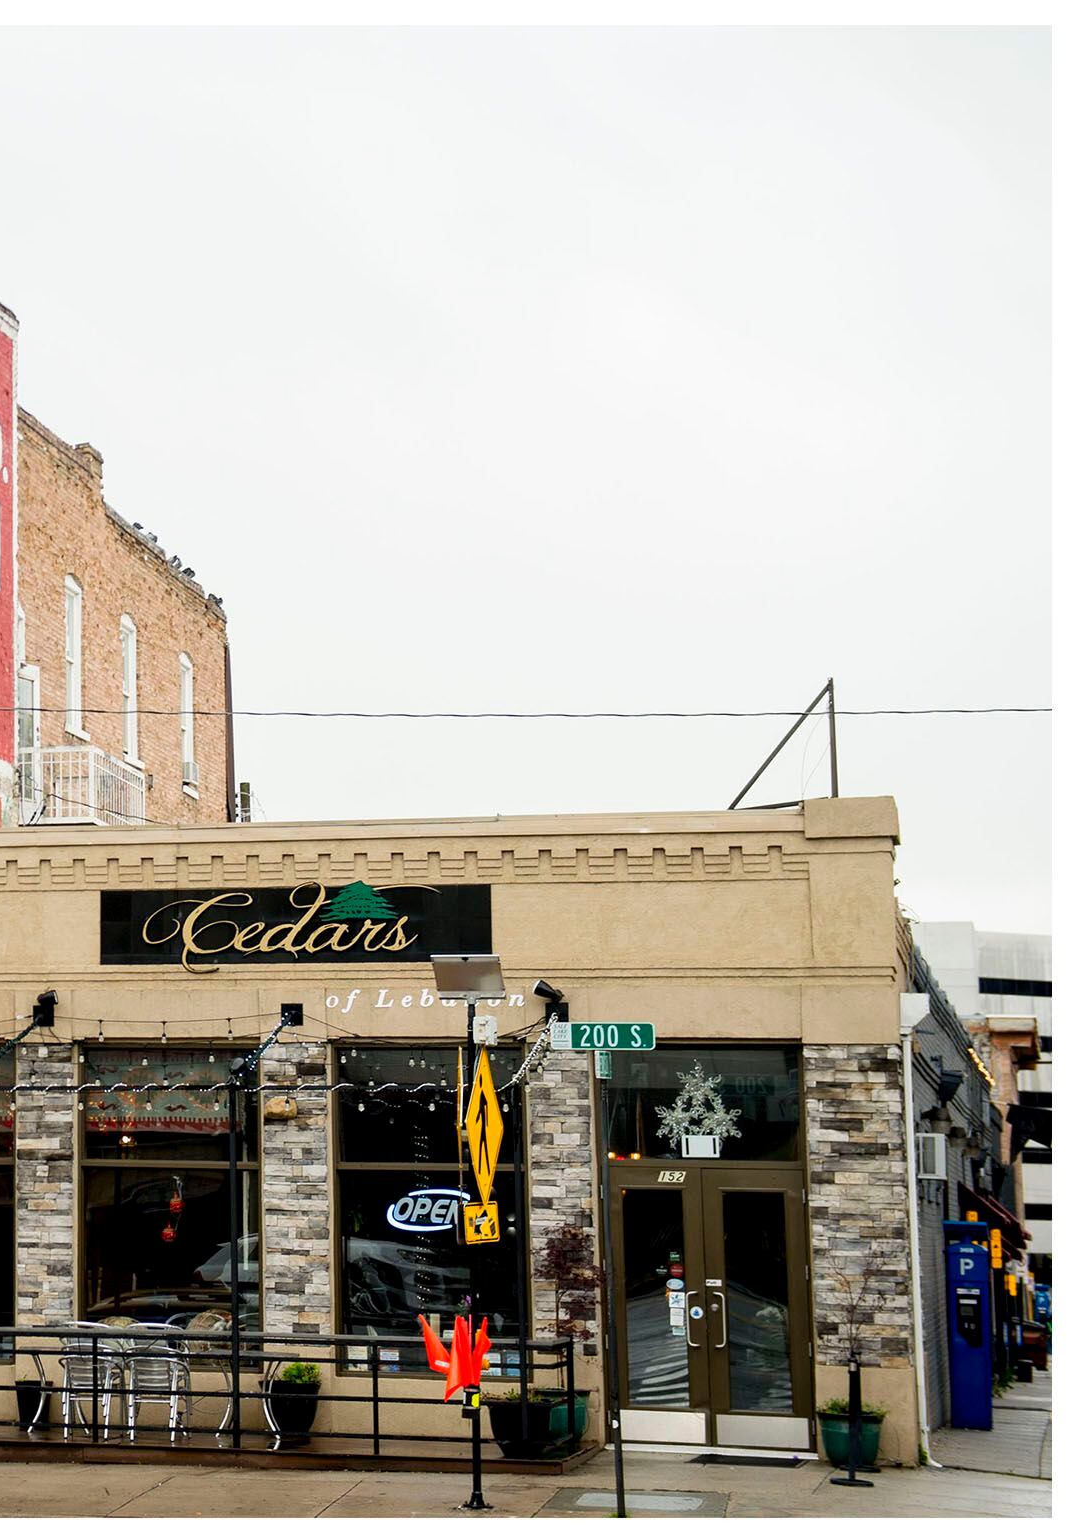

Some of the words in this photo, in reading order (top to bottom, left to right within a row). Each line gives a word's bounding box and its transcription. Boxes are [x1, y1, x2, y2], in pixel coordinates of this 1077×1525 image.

[142, 881, 432, 973] Cedars
[326, 988, 362, 1013] of
[580, 1024, 619, 1048] 200
[630, 1024, 647, 1048] S.
[660, 1171, 685, 1182] 152
[960, 1258, 974, 1276] P
